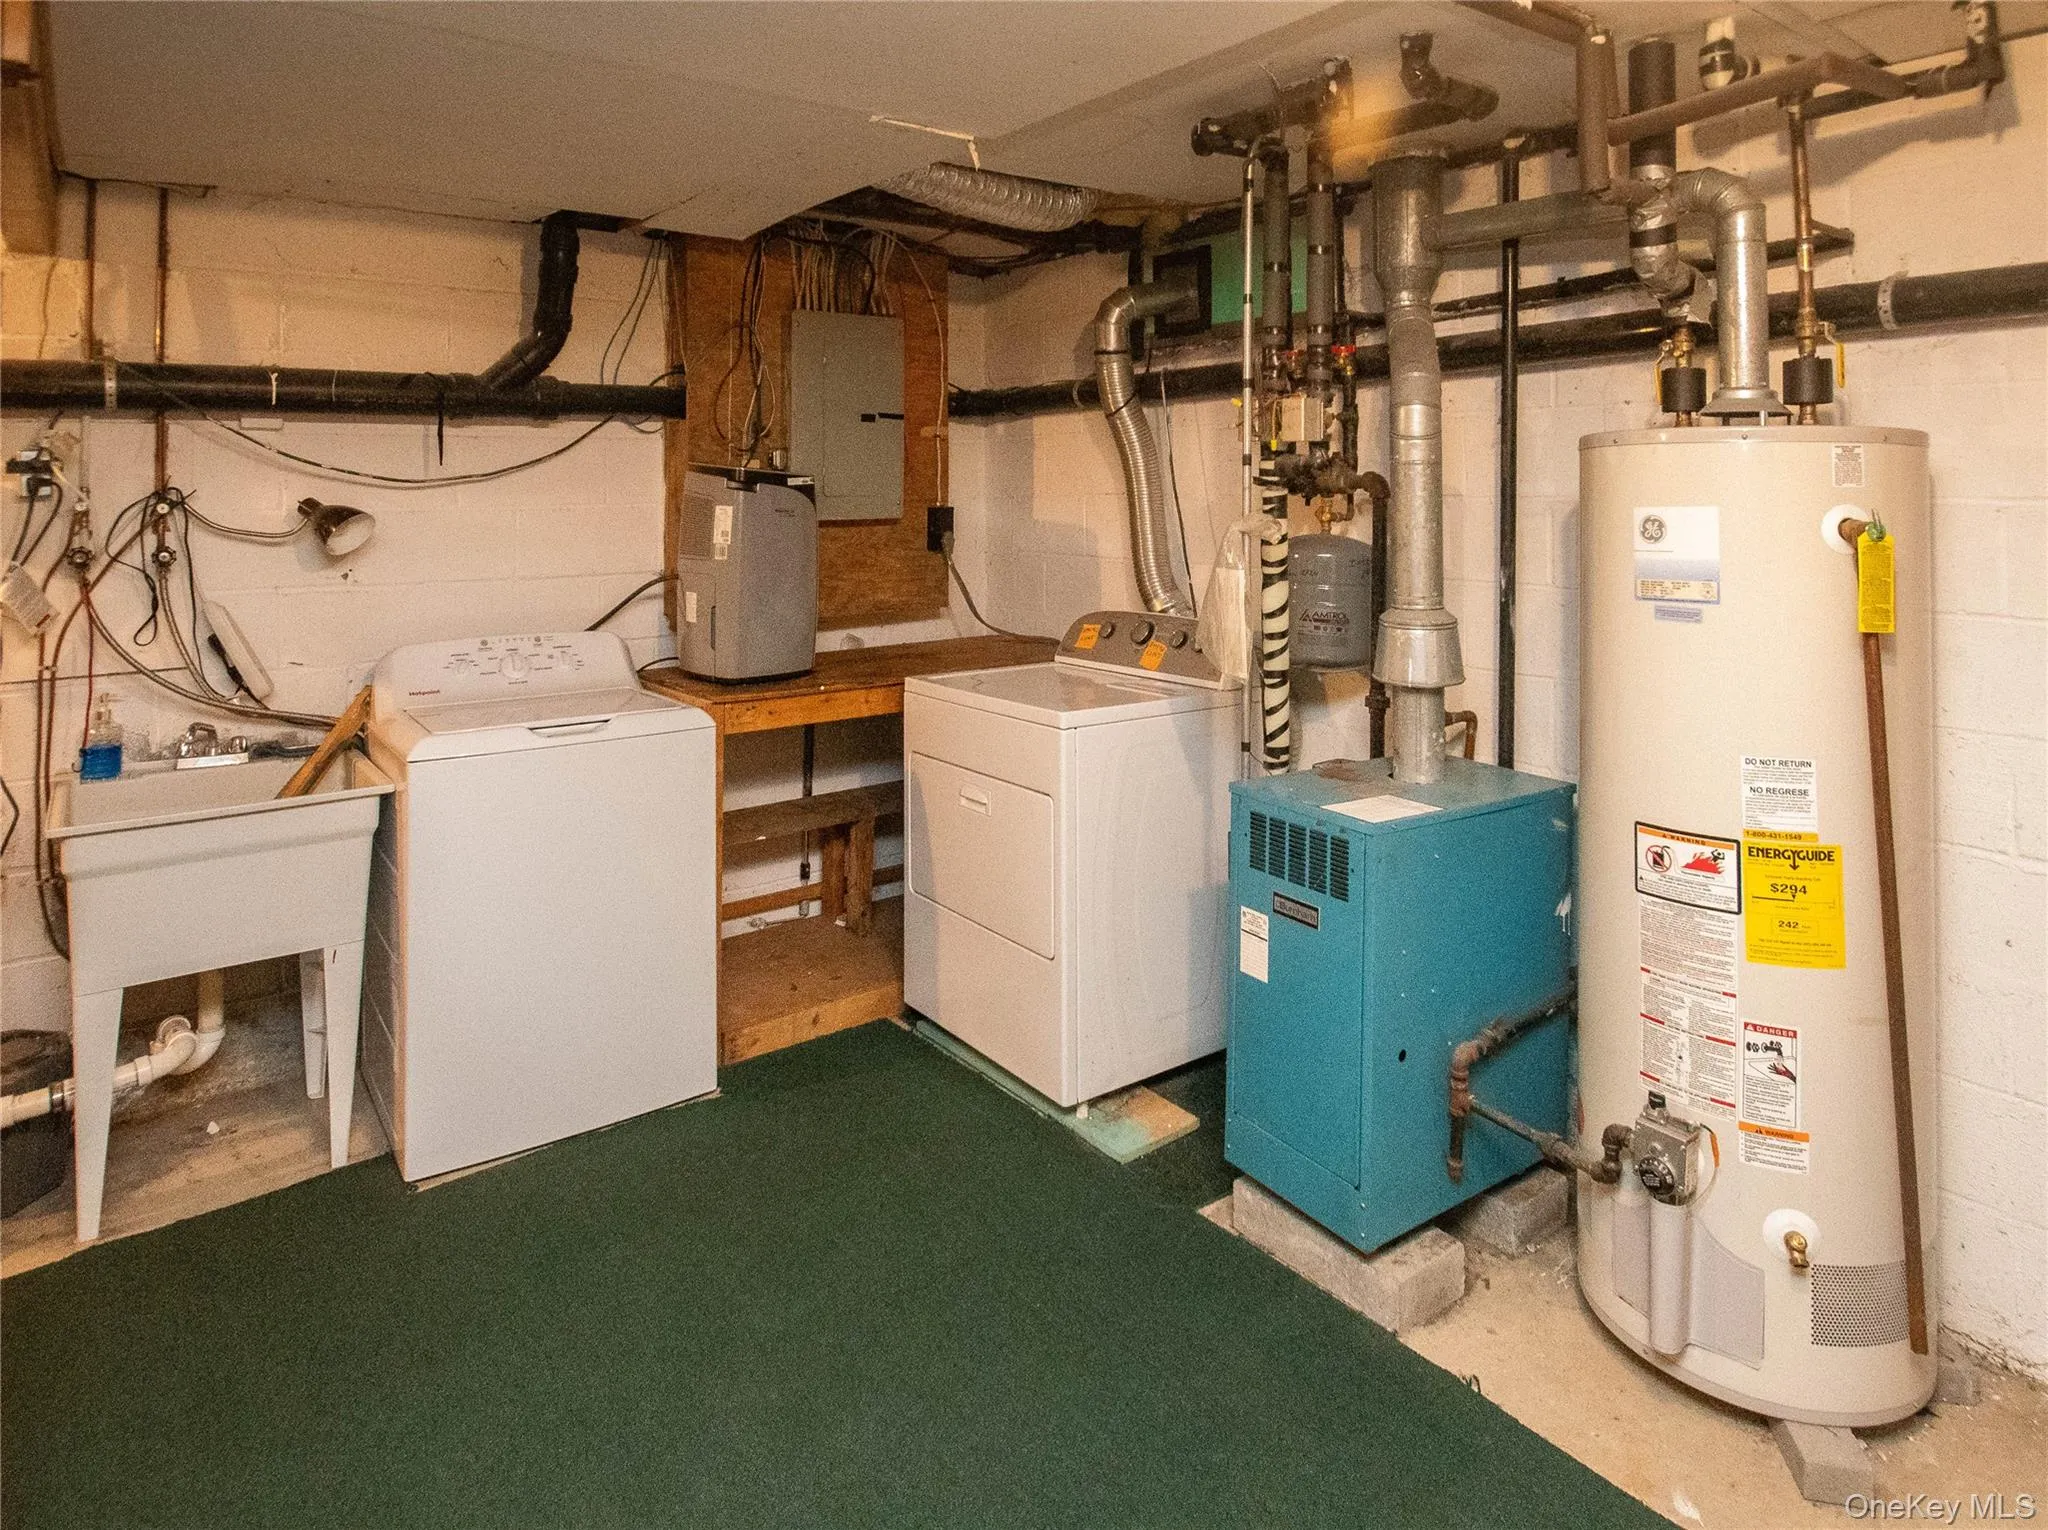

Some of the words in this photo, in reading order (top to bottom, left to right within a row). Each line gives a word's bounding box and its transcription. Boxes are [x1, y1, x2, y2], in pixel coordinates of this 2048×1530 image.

[1744, 758, 1757, 766] DO
[1759, 759, 1776, 767] NOT
[1778, 760, 1812, 768] RETURN
[1749, 786, 1763, 794] NO
[1765, 788, 1809, 796] REGRESE
[1669, 834, 1707, 846] WARNING
[1770, 883, 1808, 895] $294
[1778, 920, 1799, 929] 242
[1755, 1025, 1795, 1038] DANGER
